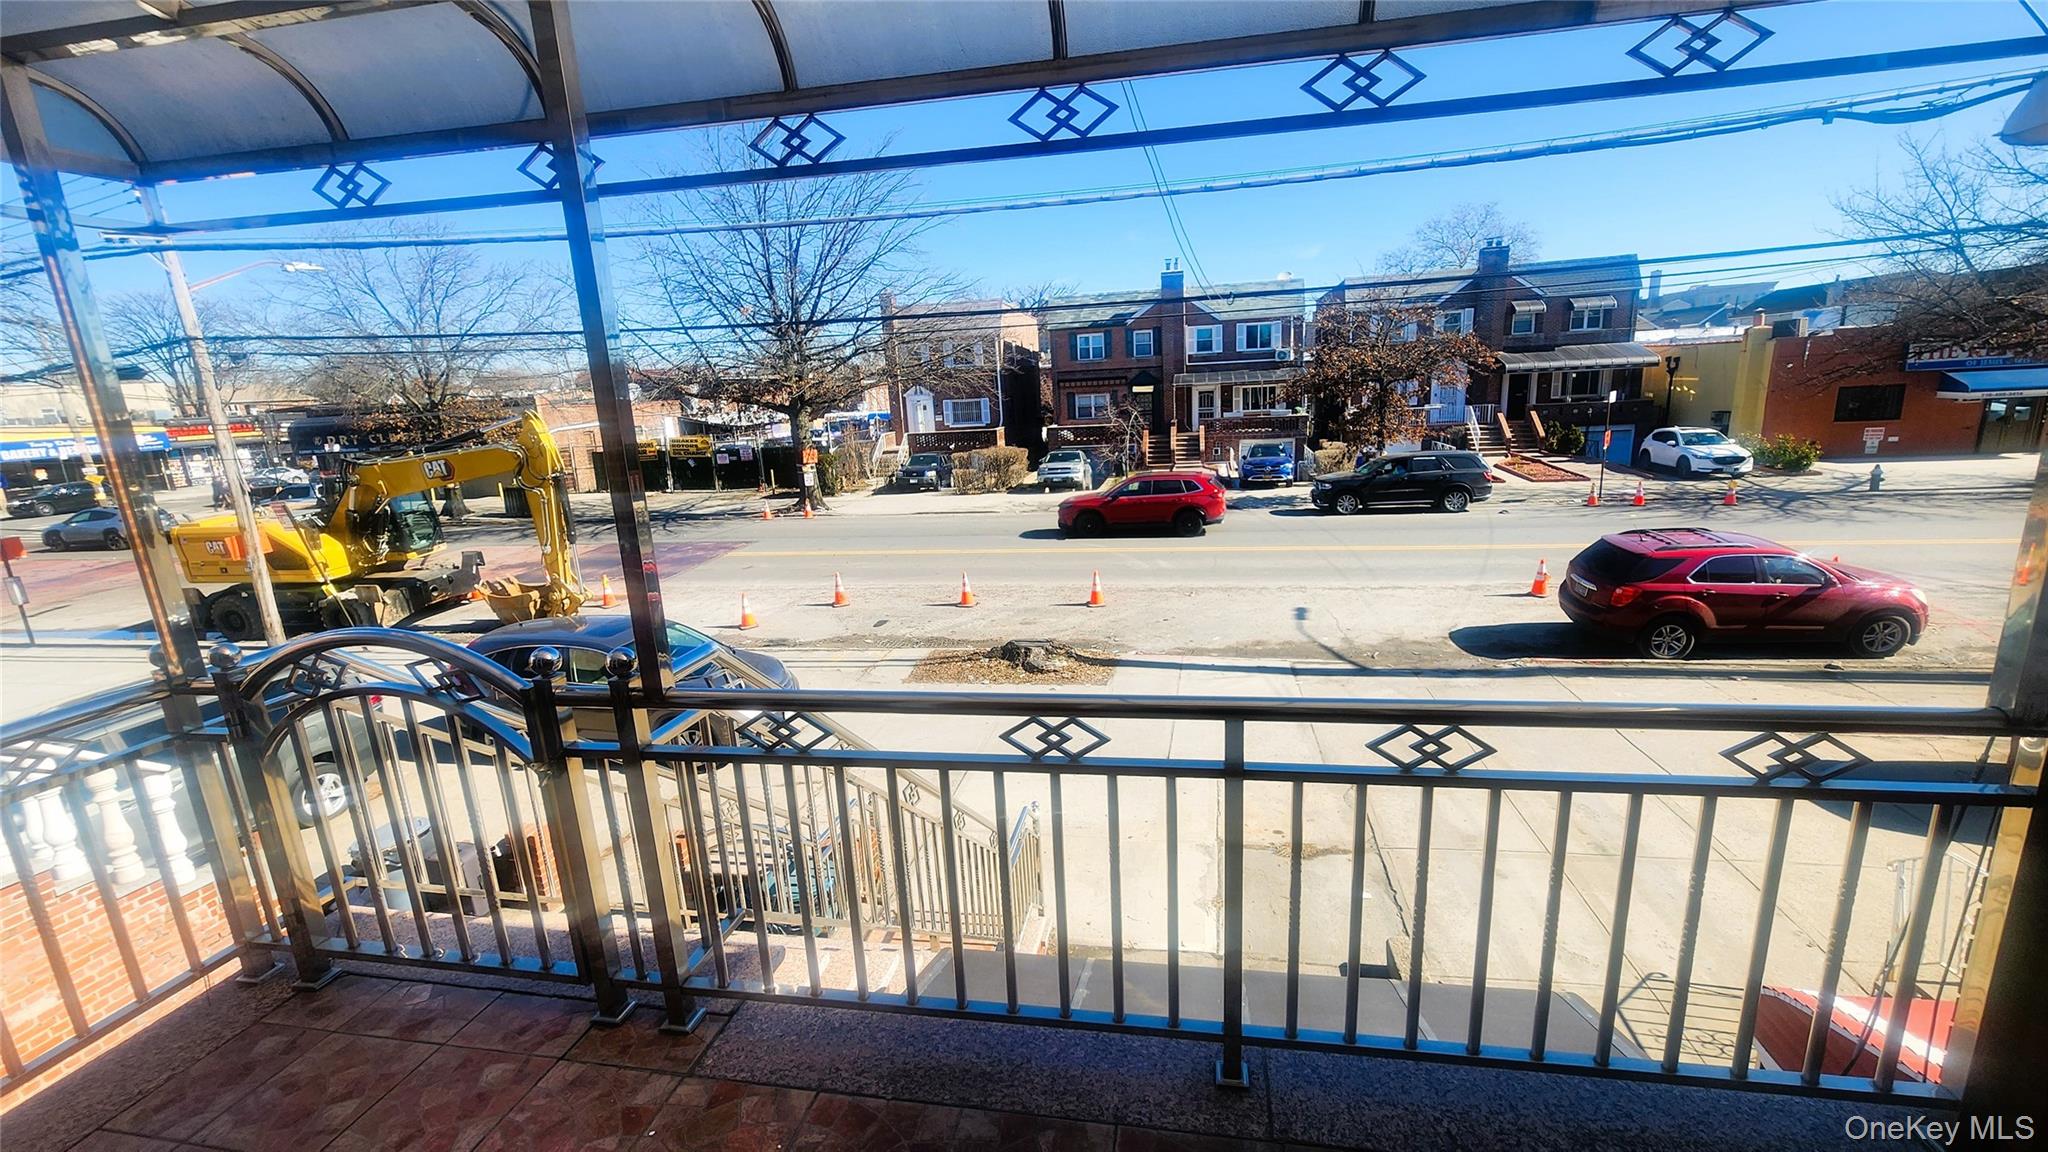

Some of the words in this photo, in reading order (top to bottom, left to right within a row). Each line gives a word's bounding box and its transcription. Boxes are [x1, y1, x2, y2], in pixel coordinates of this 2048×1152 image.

[326, 434, 358, 446] DRY
[423, 459, 448, 479] CAT
[205, 541, 226, 555] CAT
